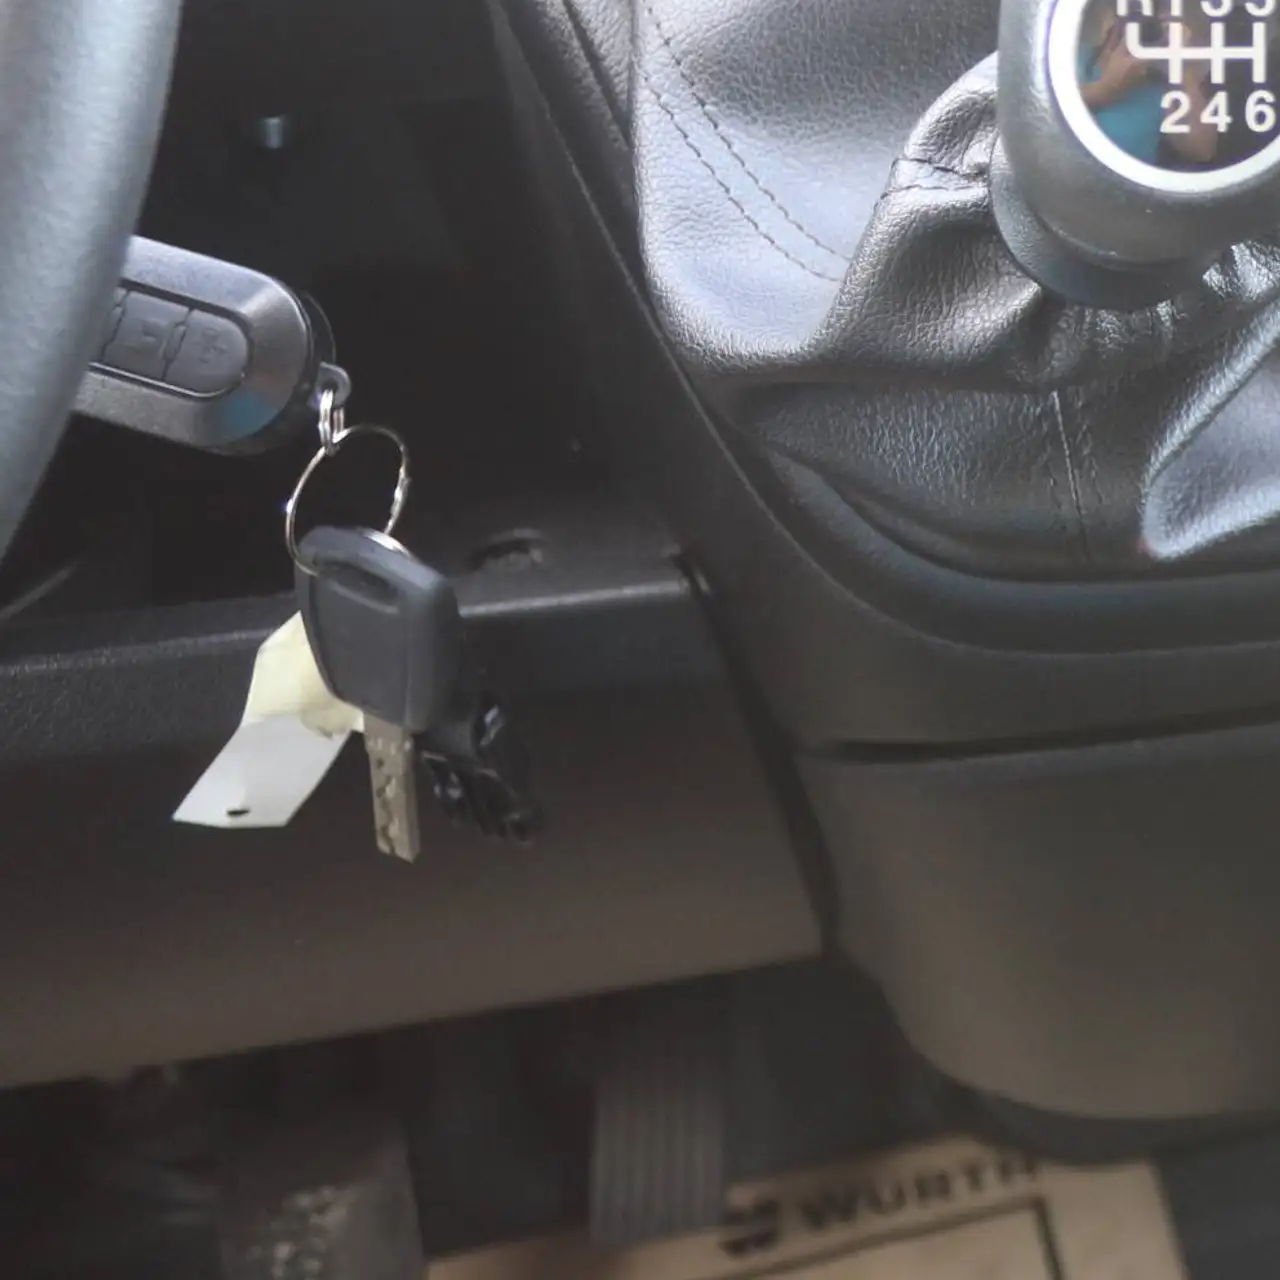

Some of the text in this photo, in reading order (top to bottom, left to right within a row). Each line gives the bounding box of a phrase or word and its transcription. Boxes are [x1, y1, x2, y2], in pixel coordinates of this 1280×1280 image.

[1160, 89, 1277, 134] 2 4 6
